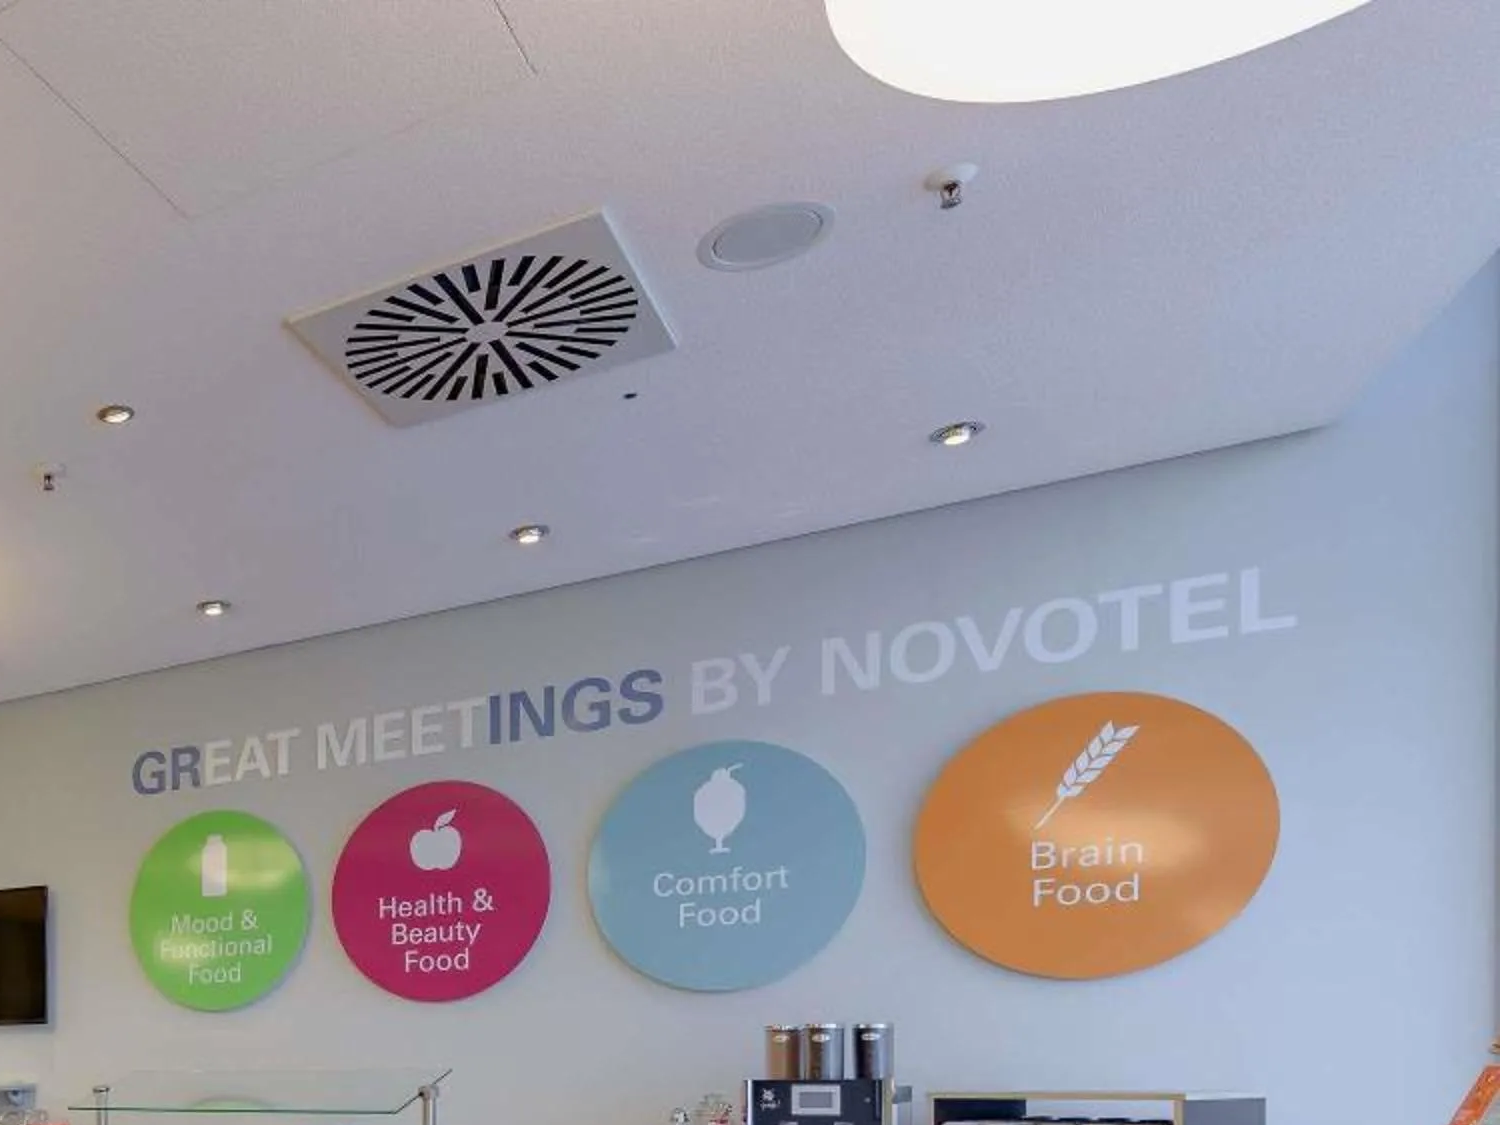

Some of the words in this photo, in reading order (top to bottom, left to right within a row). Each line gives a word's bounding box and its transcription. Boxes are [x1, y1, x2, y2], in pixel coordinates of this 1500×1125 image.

[132, 727, 301, 796] GREAT
[316, 668, 665, 770] MEETINGS
[690, 644, 791, 716] BY
[820, 566, 1299, 696] NOVOTEL
[1031, 836, 1144, 870] Brain
[653, 865, 790, 898] Comfort
[1032, 872, 1140, 908] Food
[378, 891, 463, 919] Health
[472, 887, 495, 912] &
[679, 897, 762, 929] Food
[171, 911, 234, 934] Mood
[241, 908, 259, 931] &
[390, 920, 482, 947] Beauty
[160, 934, 273, 960] Functional
[404, 948, 470, 974] Food
[189, 962, 242, 985] Food
